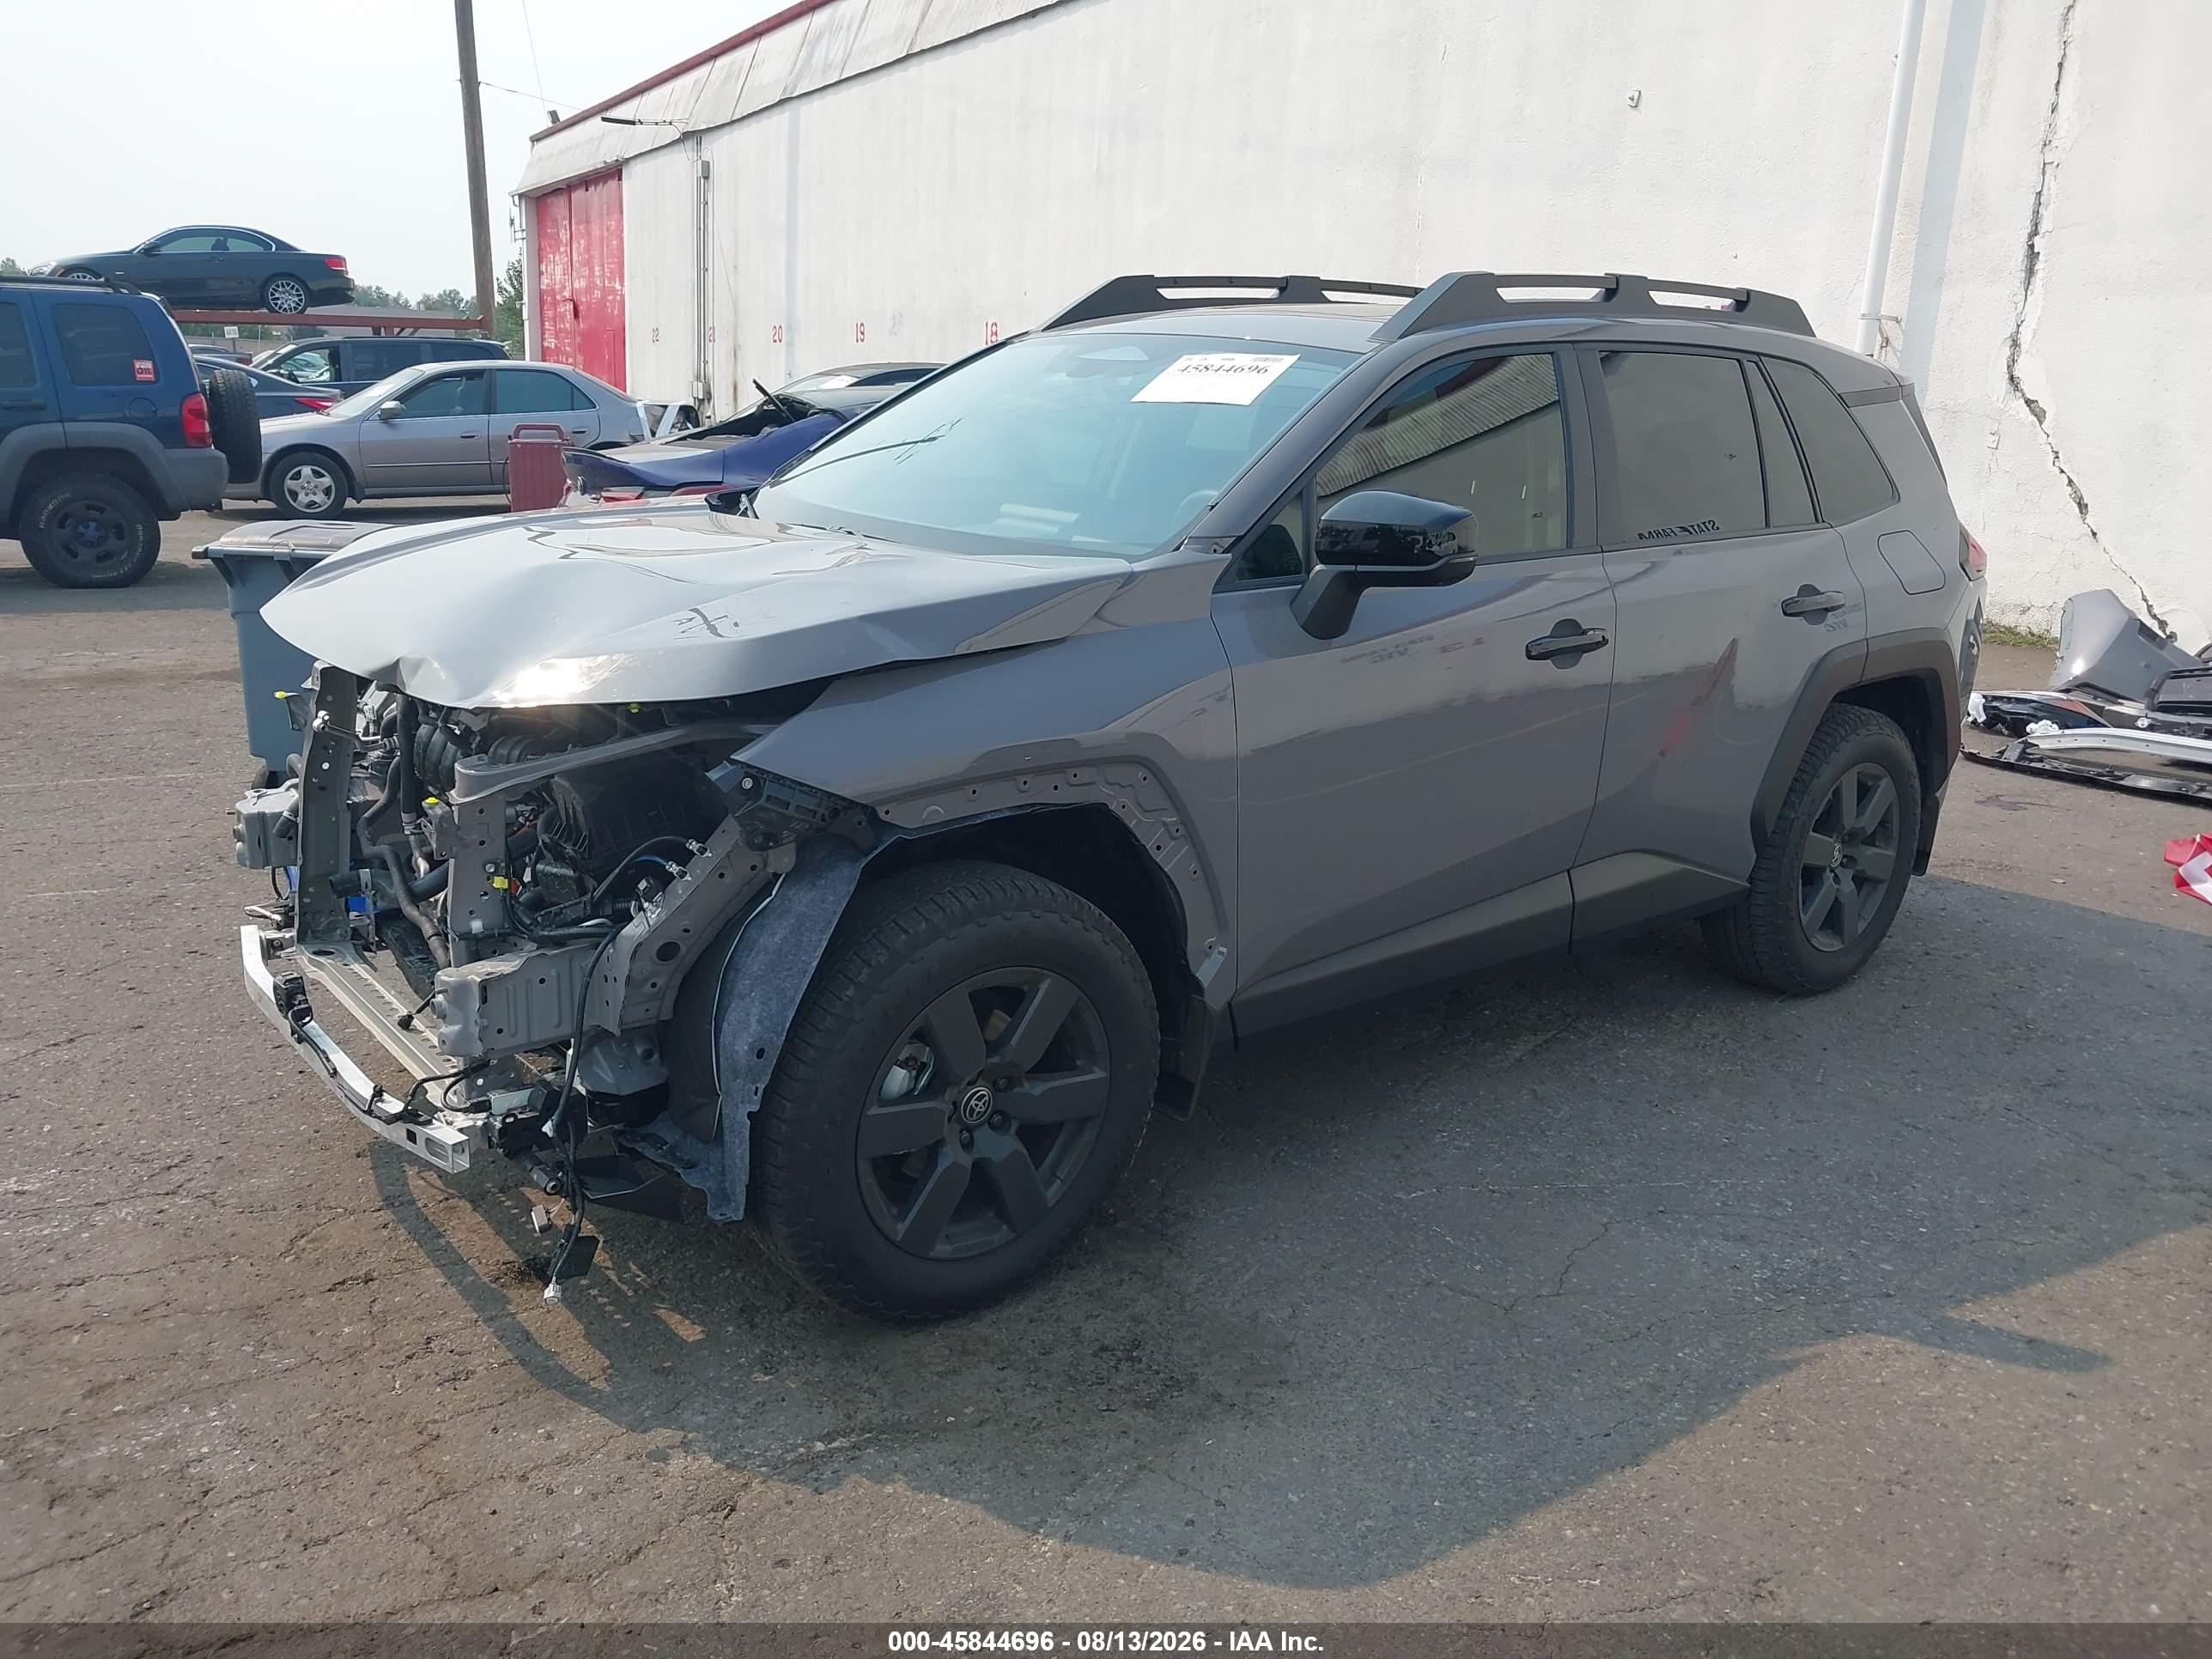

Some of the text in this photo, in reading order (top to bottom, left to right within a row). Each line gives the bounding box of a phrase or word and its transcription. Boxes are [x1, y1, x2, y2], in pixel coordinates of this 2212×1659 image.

[772, 324, 783, 343] 20
[855, 322, 866, 343] 19
[985, 321, 999, 345] 18
[1177, 363, 1271, 374] 45844696
